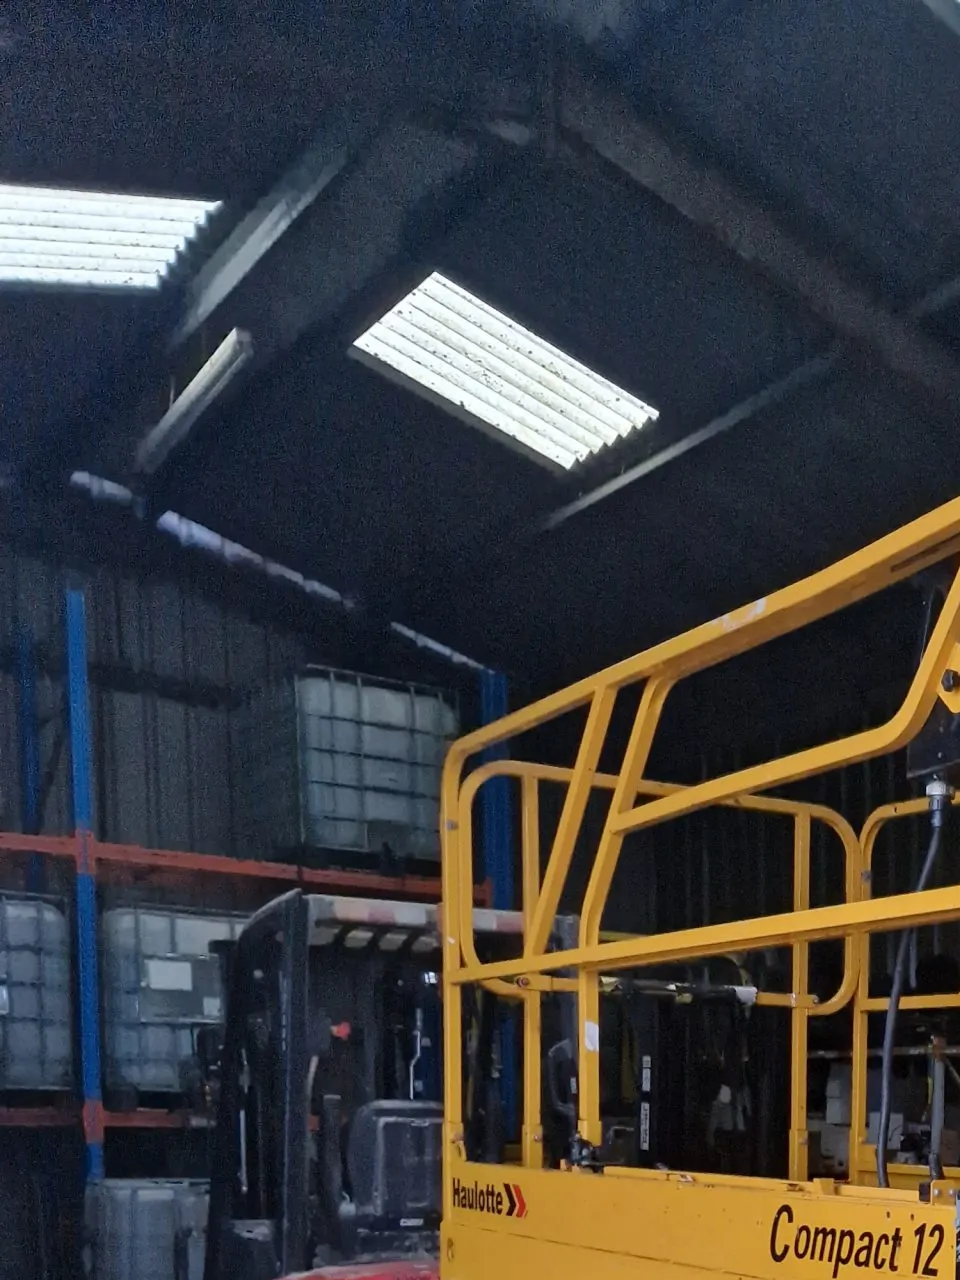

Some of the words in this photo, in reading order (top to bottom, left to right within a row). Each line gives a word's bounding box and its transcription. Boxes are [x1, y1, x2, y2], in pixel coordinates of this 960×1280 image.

[453, 1177, 503, 1215] Haulotte
[770, 1204, 902, 1279] Compact
[912, 1223, 945, 1277] 12
